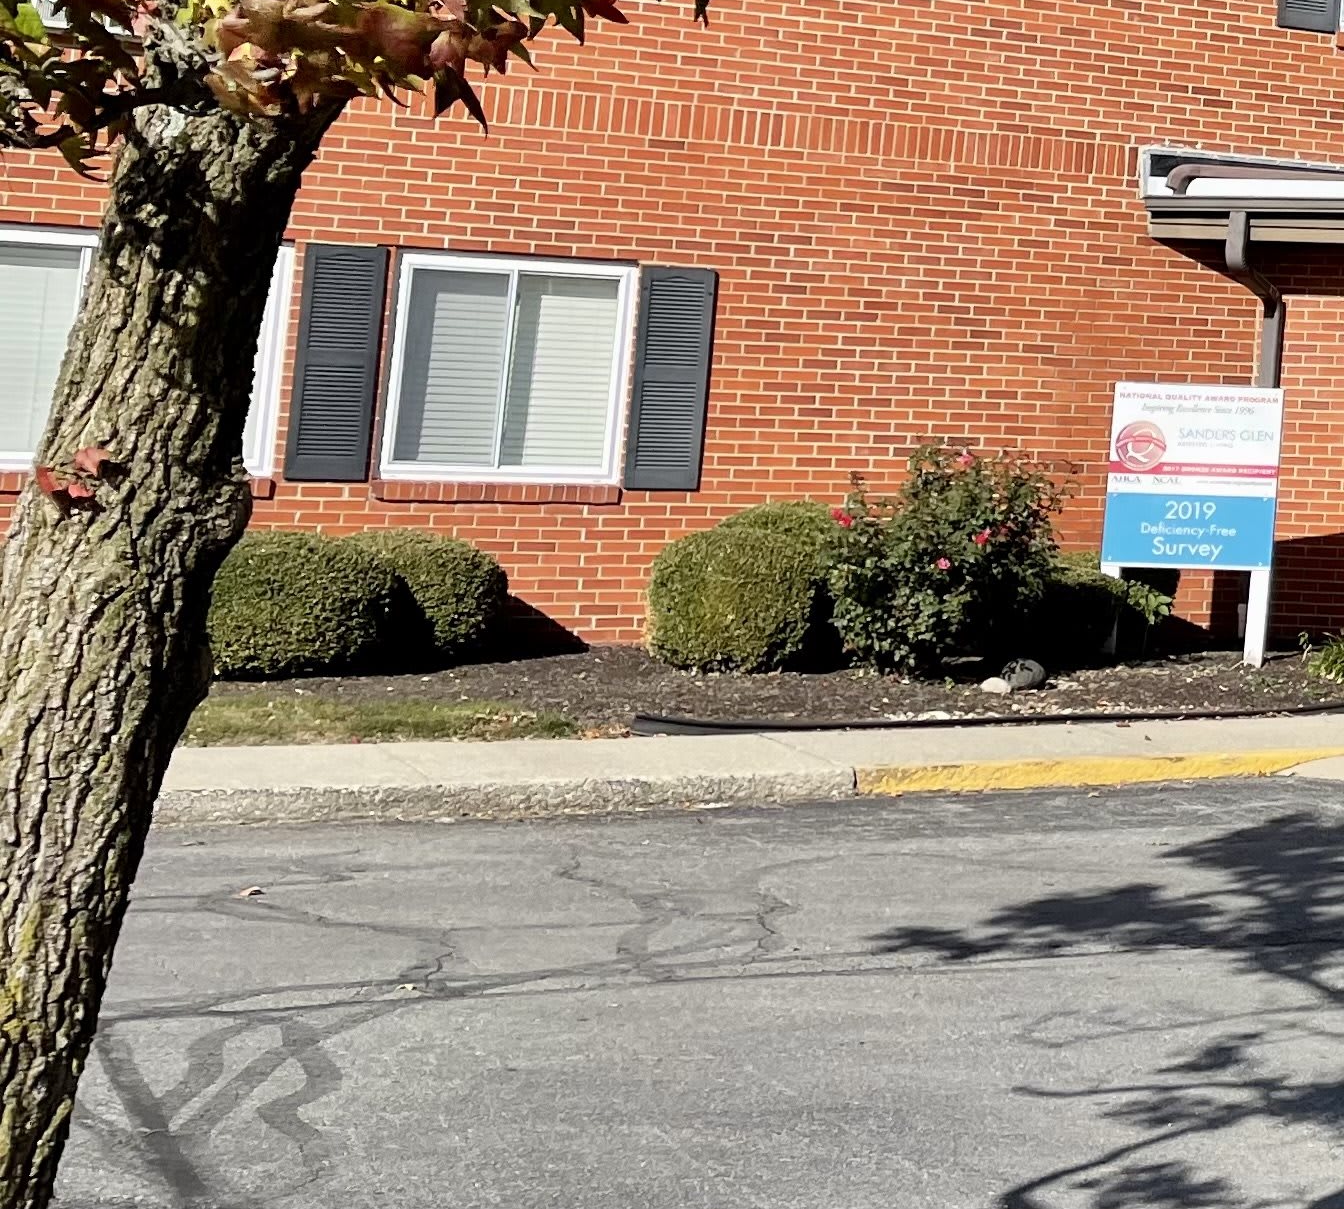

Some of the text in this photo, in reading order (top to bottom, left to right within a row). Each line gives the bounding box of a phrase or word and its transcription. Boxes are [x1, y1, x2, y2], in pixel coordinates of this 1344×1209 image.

[1119, 392, 1163, 401] NATIONAL
[1238, 396, 1279, 404] PROGRAM
[1179, 427, 1274, 442] SANDERS GLEN
[1164, 500, 1217, 521] 2019
[1140, 521, 1237, 539] Deficiency-Free
[1152, 536, 1223, 562] Survey
